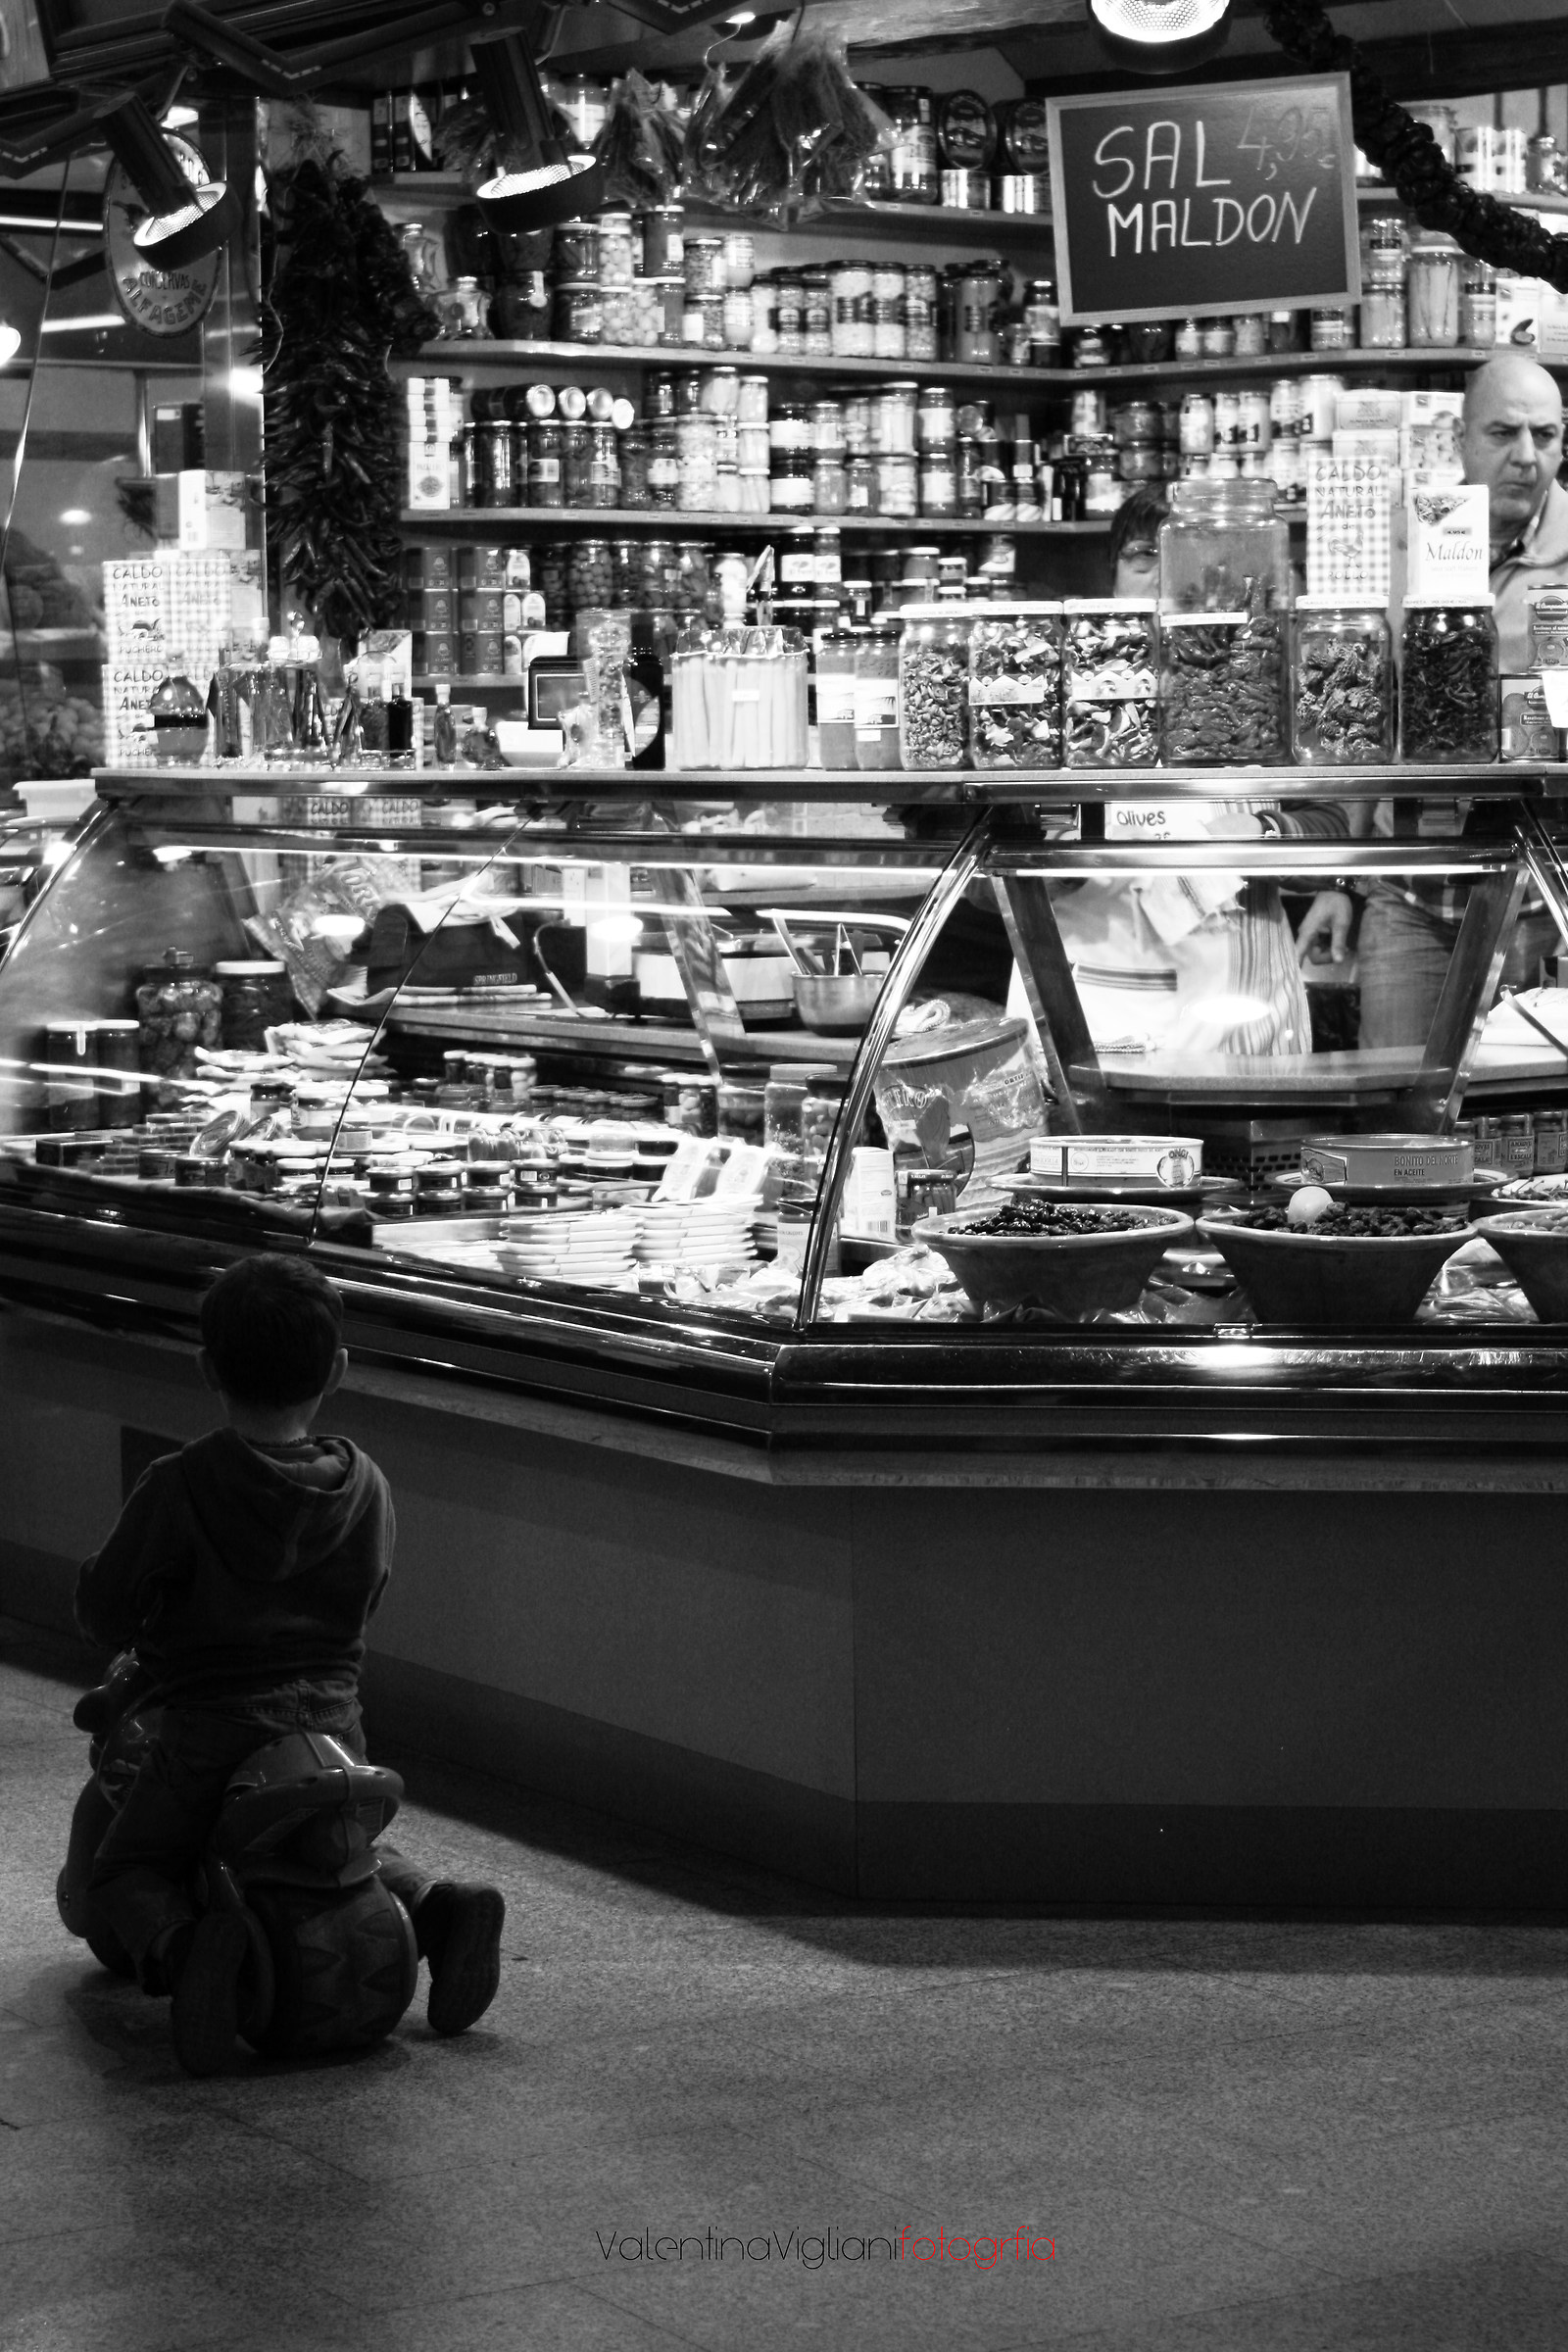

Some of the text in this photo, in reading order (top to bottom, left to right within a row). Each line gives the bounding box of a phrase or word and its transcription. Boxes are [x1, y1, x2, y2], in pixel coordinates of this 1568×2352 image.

[1093, 120, 1232, 198] SAL
[1107, 186, 1317, 257] MALDON
[122, 277, 208, 326] ALFAGEME
[1315, 465, 1383, 482] CALDO
[1314, 485, 1384, 498] NATURAL
[1320, 500, 1377, 519] ANETO
[1426, 540, 1483, 561] Maldon
[113, 565, 163, 579] CALDO
[121, 593, 161, 608] ANETO
[114, 669, 164, 683] CALDO
[311, 802, 349, 815] CALDO
[381, 800, 419, 814] CALDO
[1394, 1153, 1459, 1166] BONITO DEL NORTE
